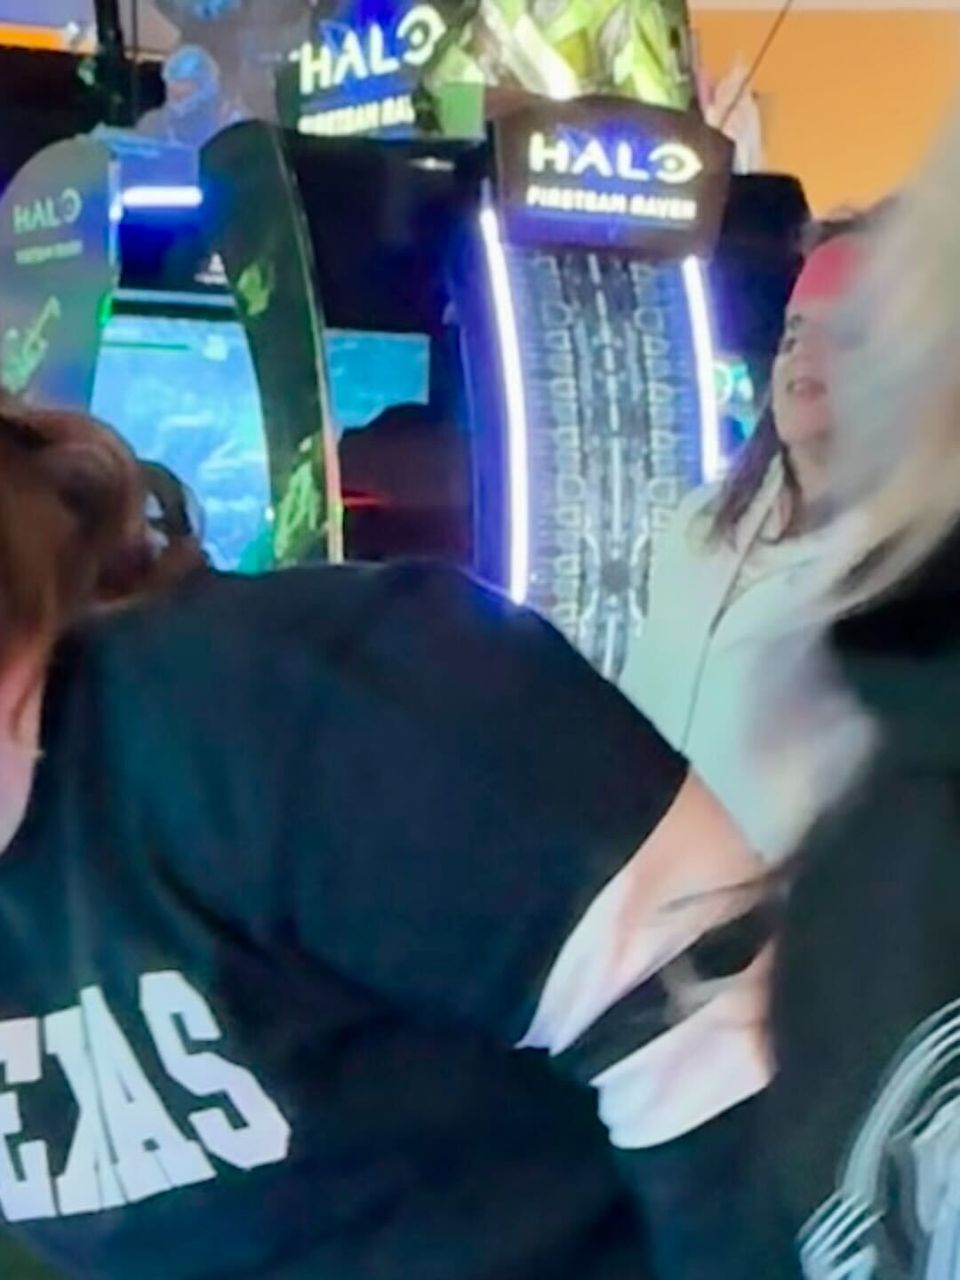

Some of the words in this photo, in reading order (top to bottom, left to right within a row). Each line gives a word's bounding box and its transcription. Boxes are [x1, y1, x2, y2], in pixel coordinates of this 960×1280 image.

[299, 4, 447, 94] HALO
[528, 131, 703, 184] HALO
[13, 188, 83, 234] HALO
